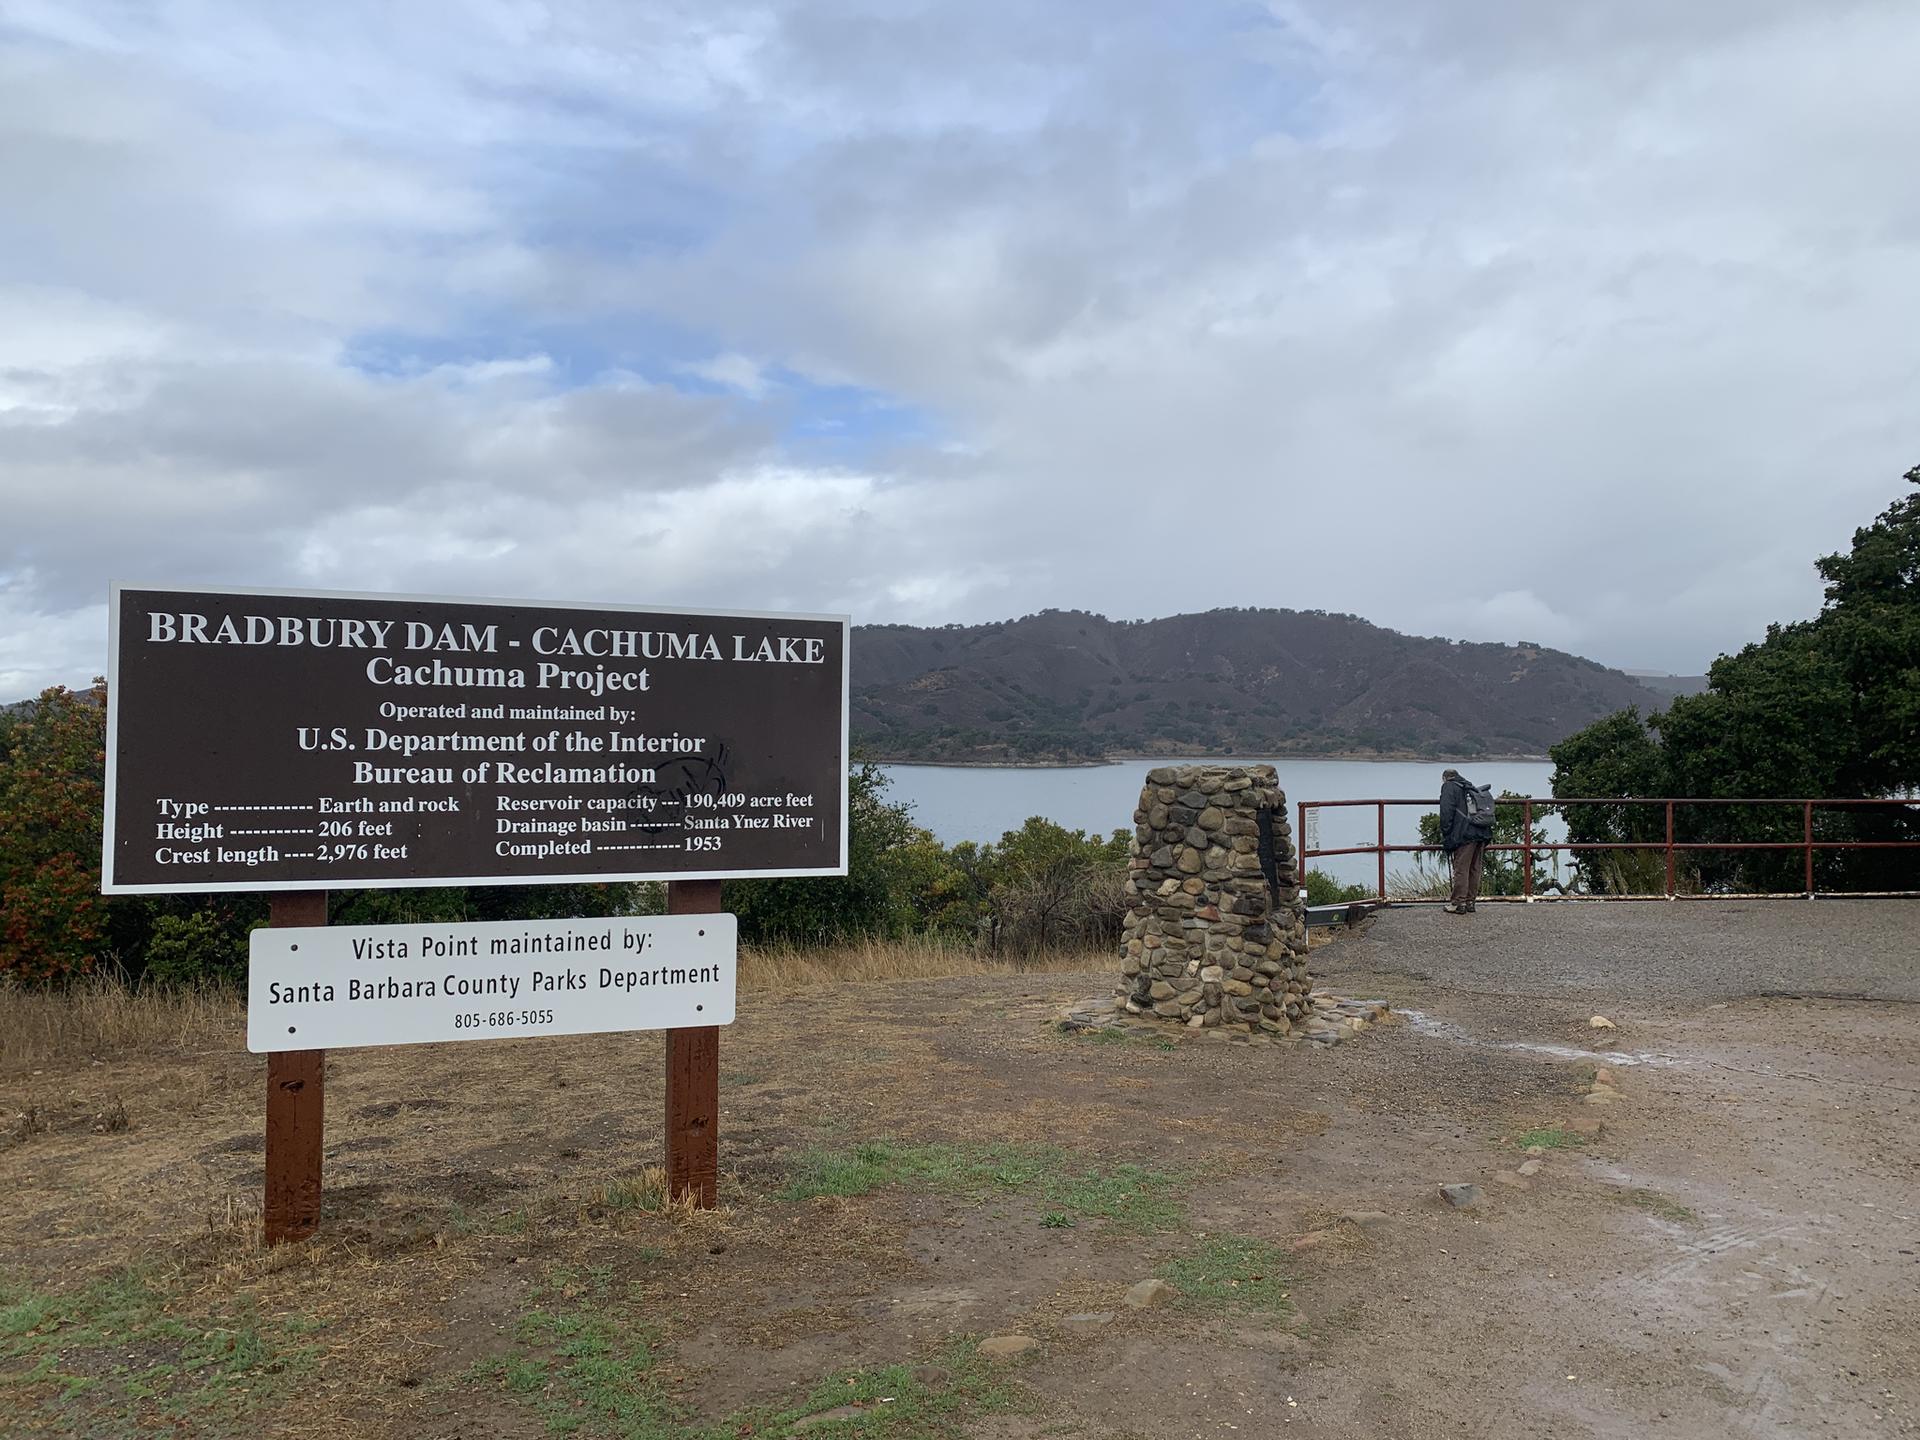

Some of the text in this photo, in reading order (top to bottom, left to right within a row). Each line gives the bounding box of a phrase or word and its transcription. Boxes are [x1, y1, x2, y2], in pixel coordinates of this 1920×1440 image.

[146, 612, 395, 649] BRADBURY
[404, 621, 499, 653] DAM
[532, 626, 724, 661] CACHUMA
[731, 635, 825, 664] LAKE
[366, 656, 650, 697] Cachuma Project
[379, 701, 636, 725] Operated and maintained by:
[296, 727, 706, 757] U.S. Department of the Interior
[352, 761, 657, 784] Bureau of Reclamation
[156, 798, 209, 819] Type
[318, 797, 374, 814] Earth
[378, 796, 415, 813] and
[417, 796, 460, 812] rock
[496, 795, 583, 811] Reservoir
[586, 794, 658, 814] capacity
[685, 792, 746, 811] 190,409
[749, 796, 783, 808] acre
[785, 792, 814, 807] feet
[155, 822, 224, 844] Height
[318, 820, 353, 837] 206
[357, 820, 393, 837] feet
[495, 817, 577, 837] Drainage
[580, 816, 627, 832] basin
[683, 815, 730, 830] Santa
[731, 814, 770, 829] Ynez
[772, 813, 814, 829] River
[155, 847, 211, 865] Crest
[216, 845, 279, 867] length
[316, 843, 368, 864] 2,976
[373, 843, 408, 860] feet
[495, 839, 592, 860] Completed
[684, 836, 722, 852] 1953
[352, 928, 652, 960] Vista Point maintained by:
[269, 963, 720, 1005] Santa Barbara County Parks Department
[454, 1009, 553, 1029] 805-686-5055
